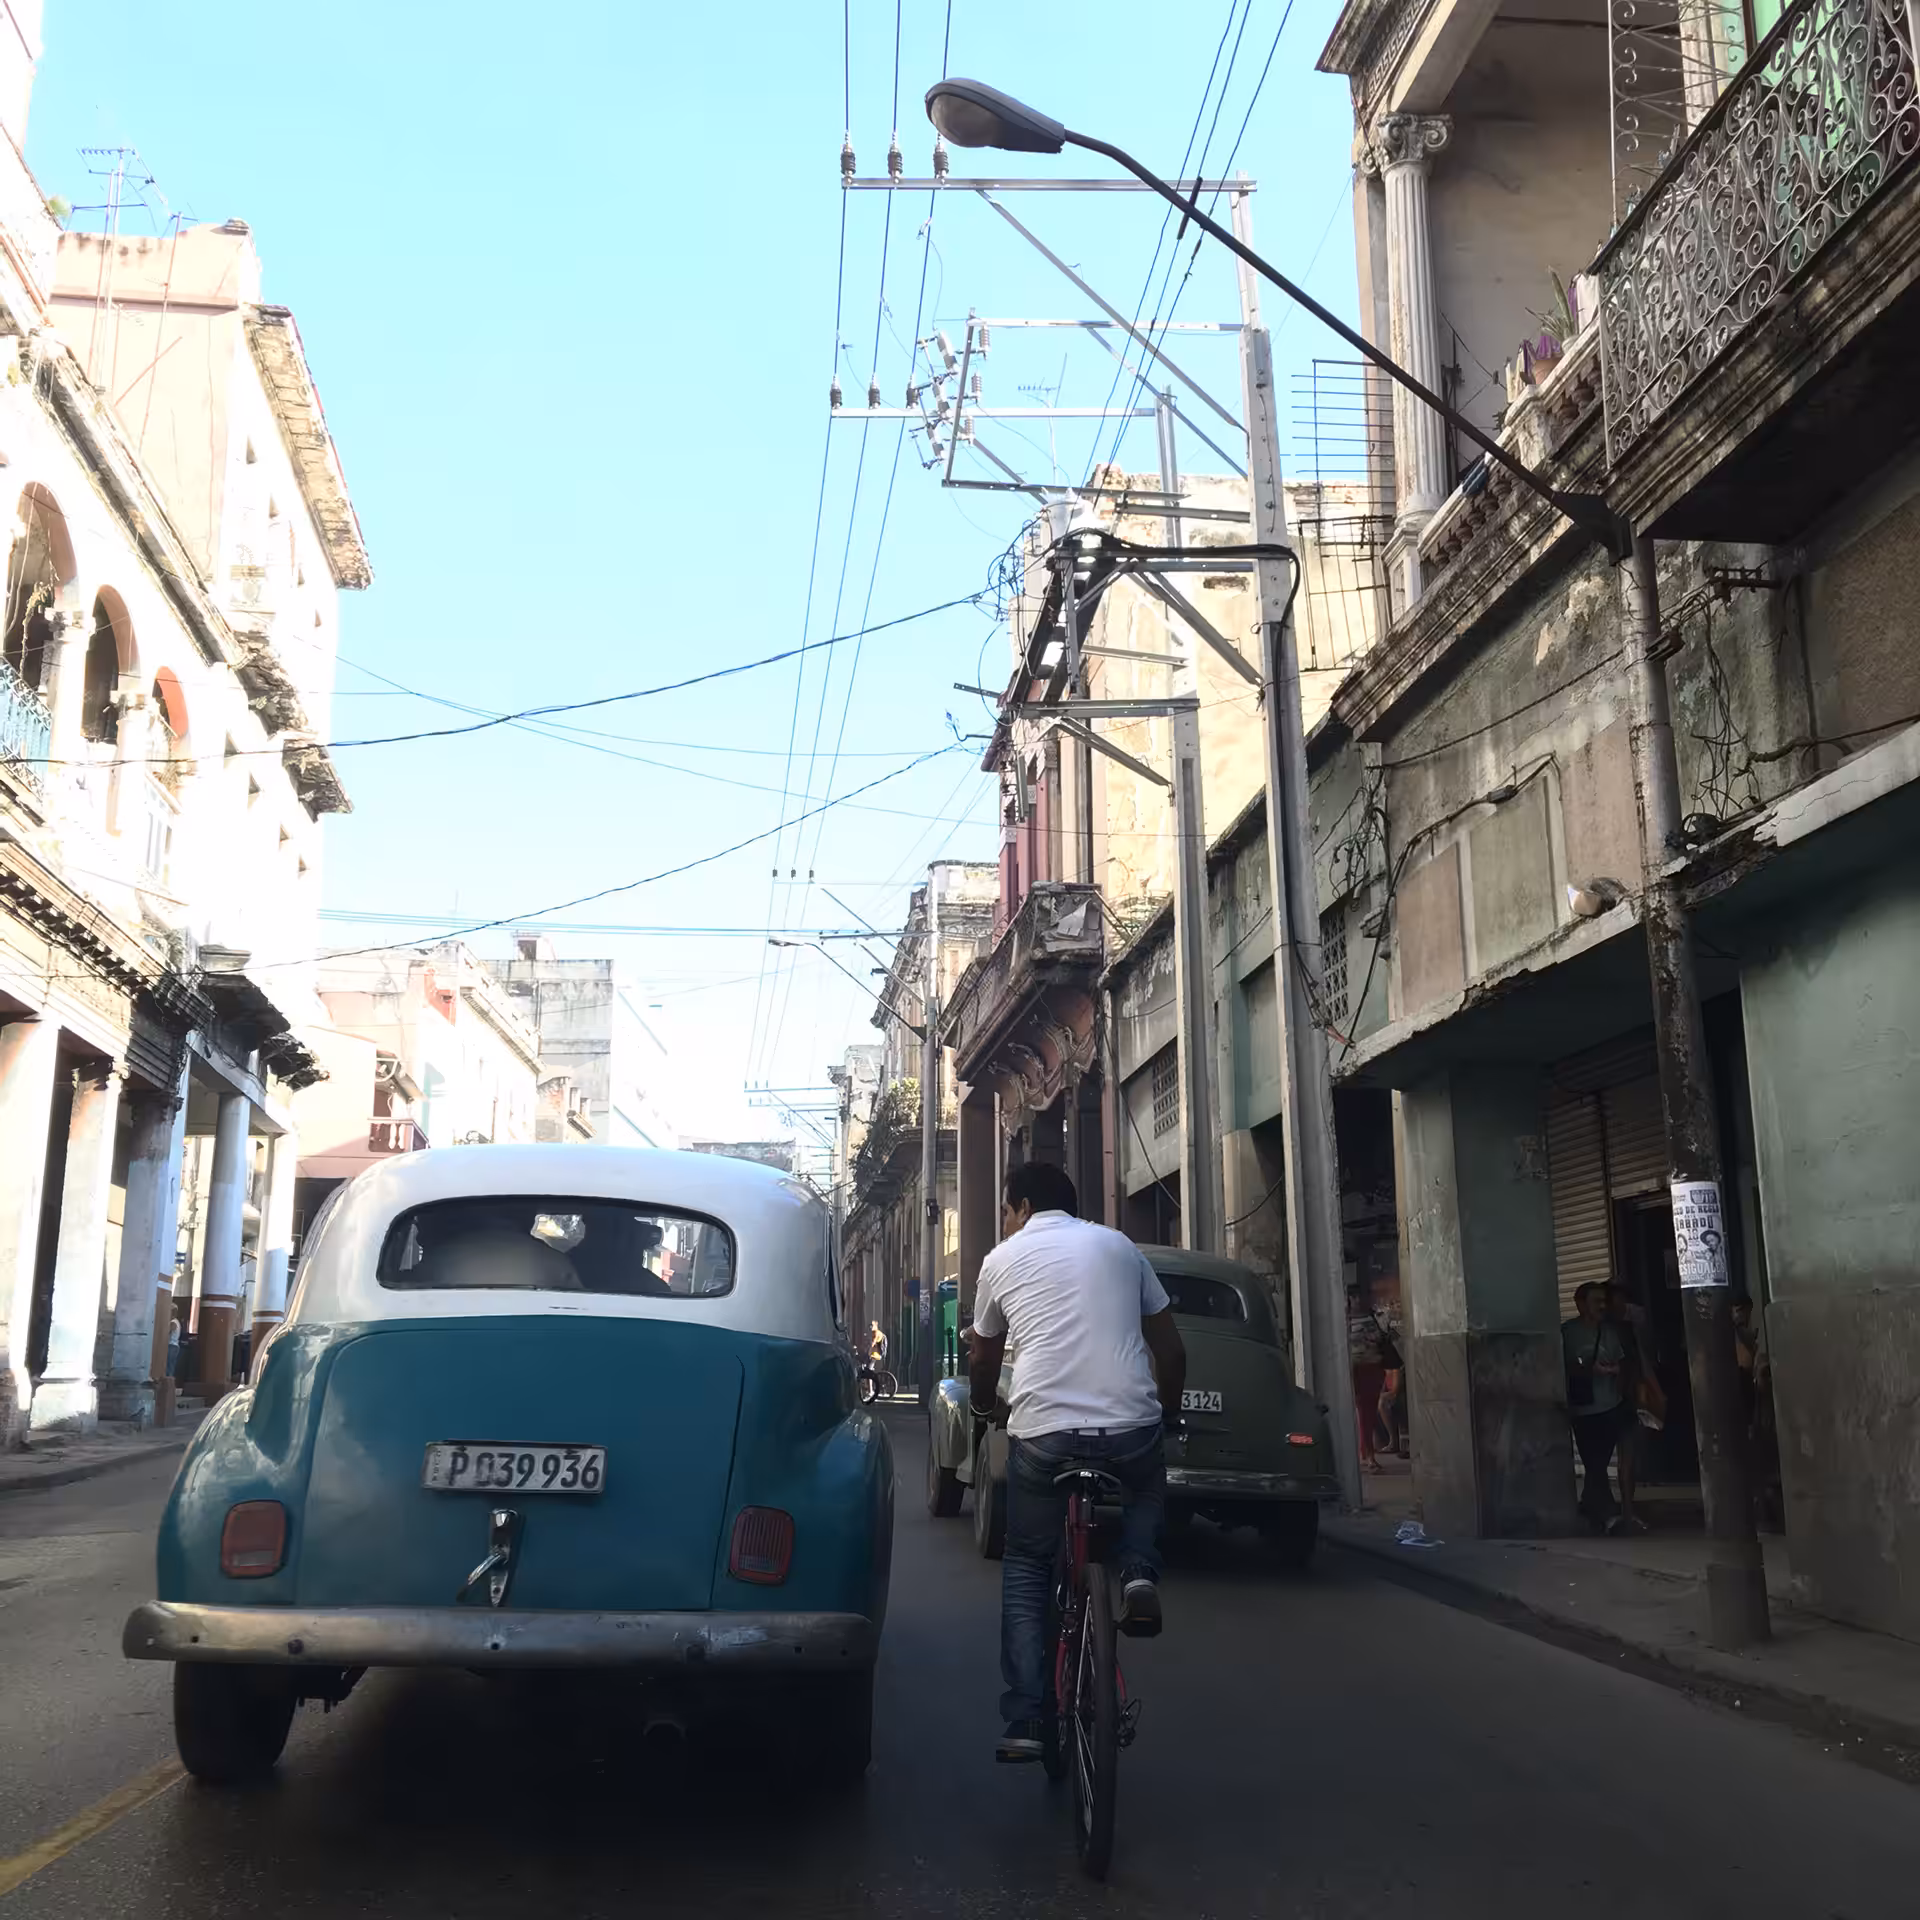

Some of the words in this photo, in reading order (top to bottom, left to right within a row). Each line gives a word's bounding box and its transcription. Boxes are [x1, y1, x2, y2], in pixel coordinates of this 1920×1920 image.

[1194, 1393, 1220, 1410] 124
[448, 1452, 469, 1486] P
[541, 1454, 600, 1489] 936
